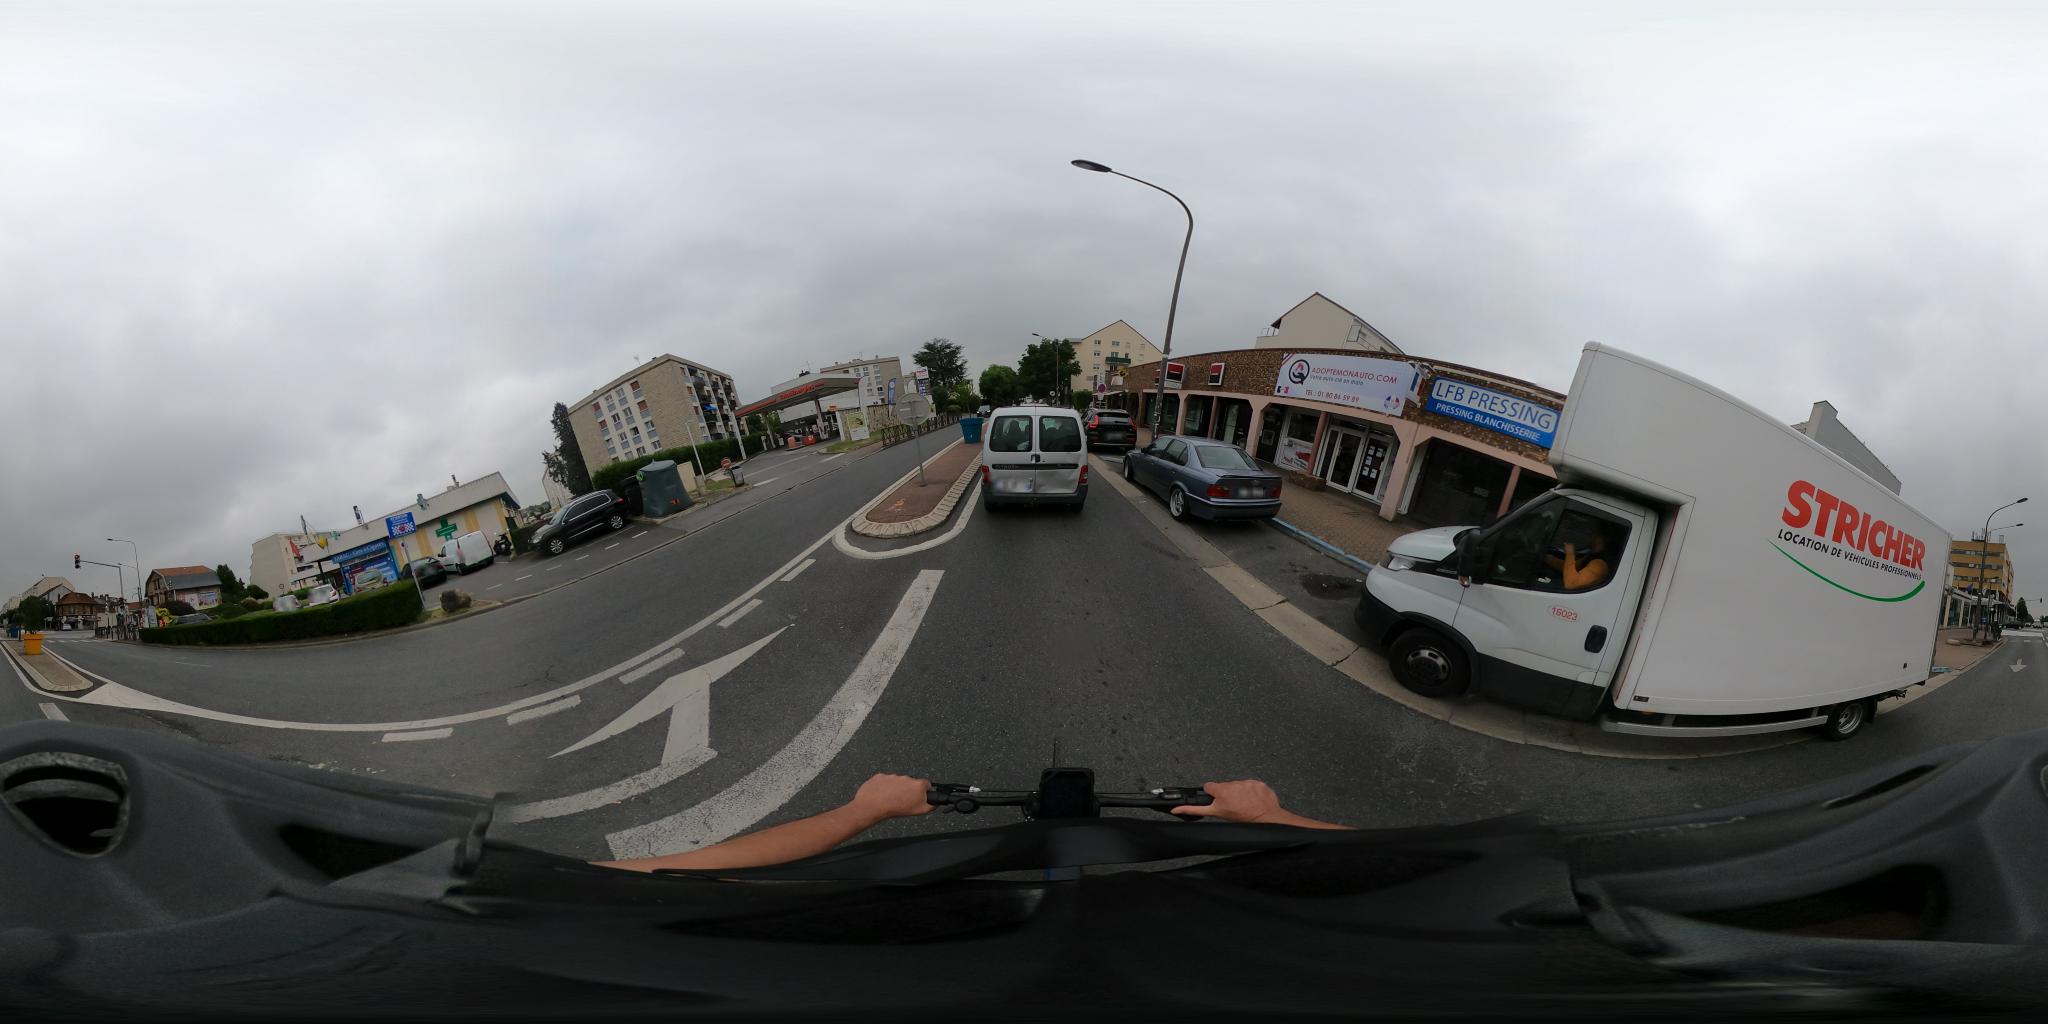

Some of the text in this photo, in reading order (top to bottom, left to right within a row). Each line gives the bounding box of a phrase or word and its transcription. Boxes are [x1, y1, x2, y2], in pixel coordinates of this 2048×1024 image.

[1311, 367, 1397, 384] ADOPTEMONAUTO.COM
[1435, 402, 1541, 441] PRESSING BLANCHISSERIE
[1436, 382, 1552, 430] LFB PRESSING
[1782, 480, 1926, 571] STRICHER
[1777, 529, 1922, 581] LOCATION DE VEHICULES PROFESSIONNELS
